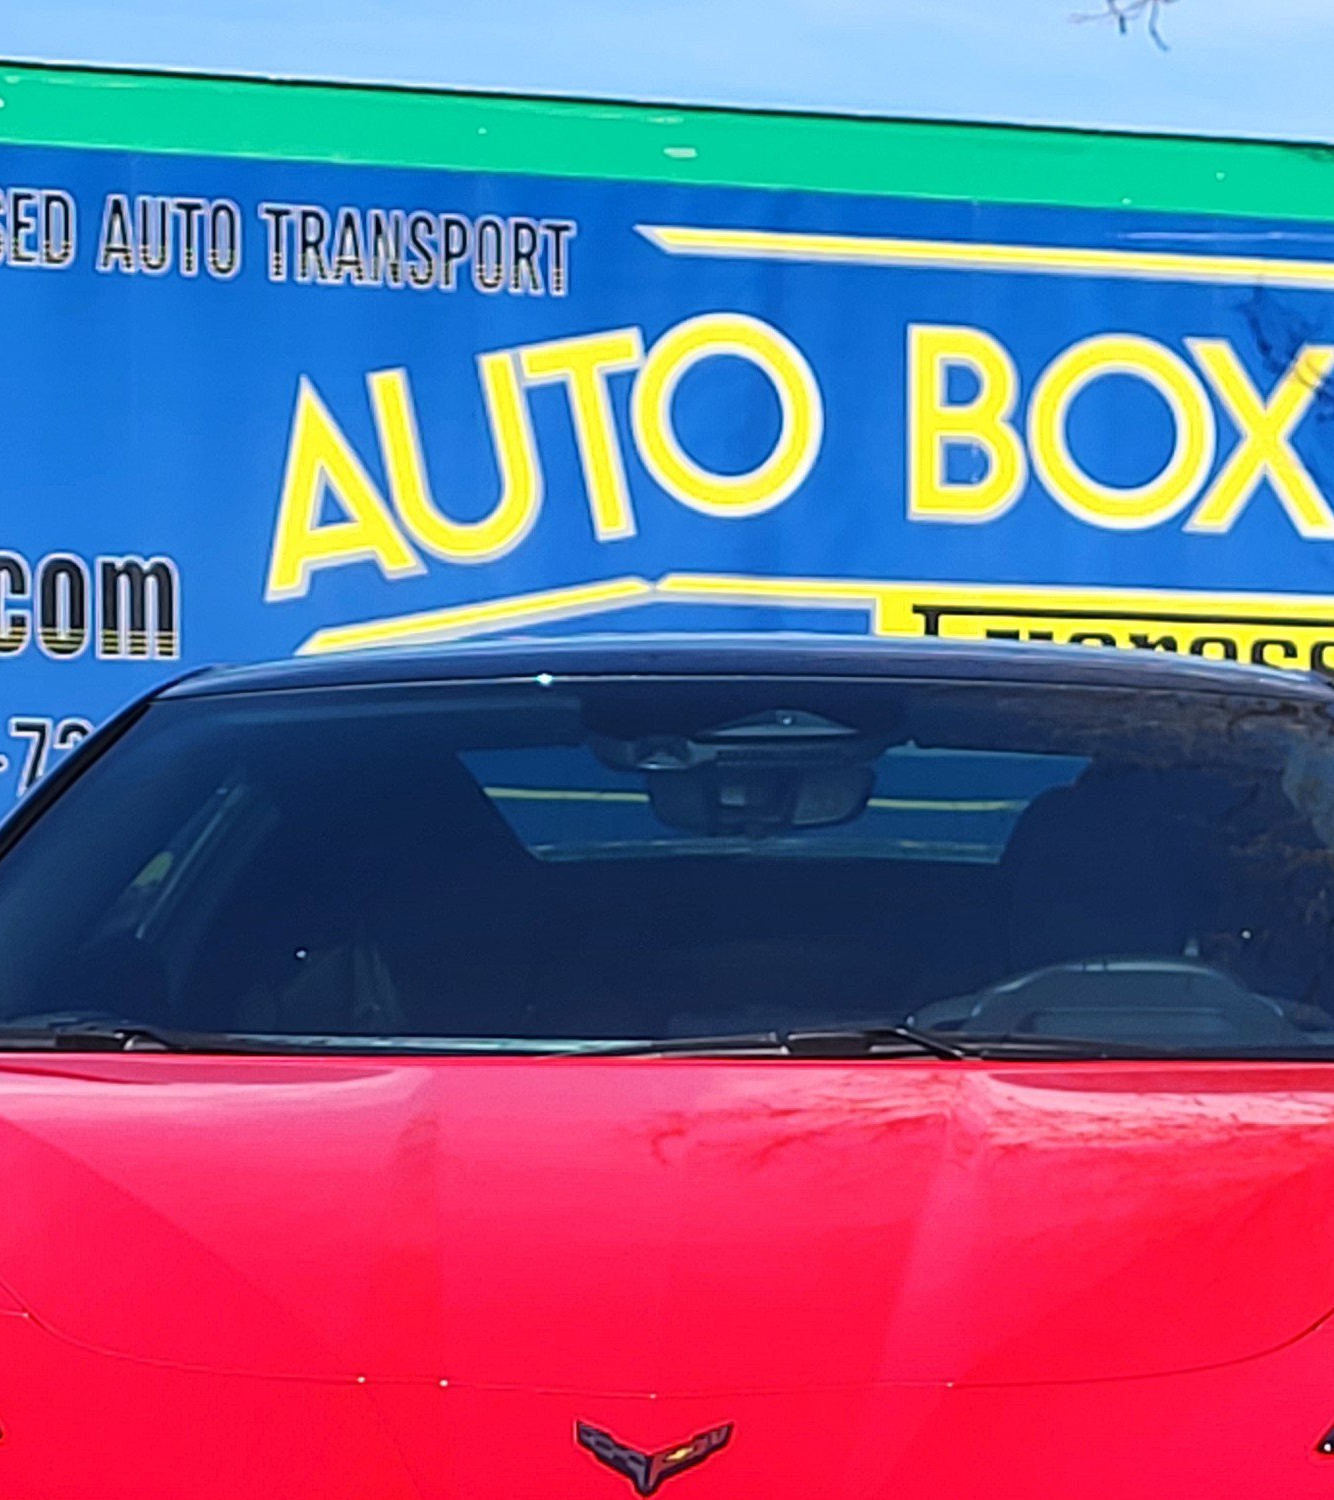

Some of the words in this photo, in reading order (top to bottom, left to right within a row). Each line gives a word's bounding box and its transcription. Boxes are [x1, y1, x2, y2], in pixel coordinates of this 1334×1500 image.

[97, 194, 244, 278] AUTO
[258, 202, 578, 296] TRANSPORT
[264, 311, 825, 603] AUTO
